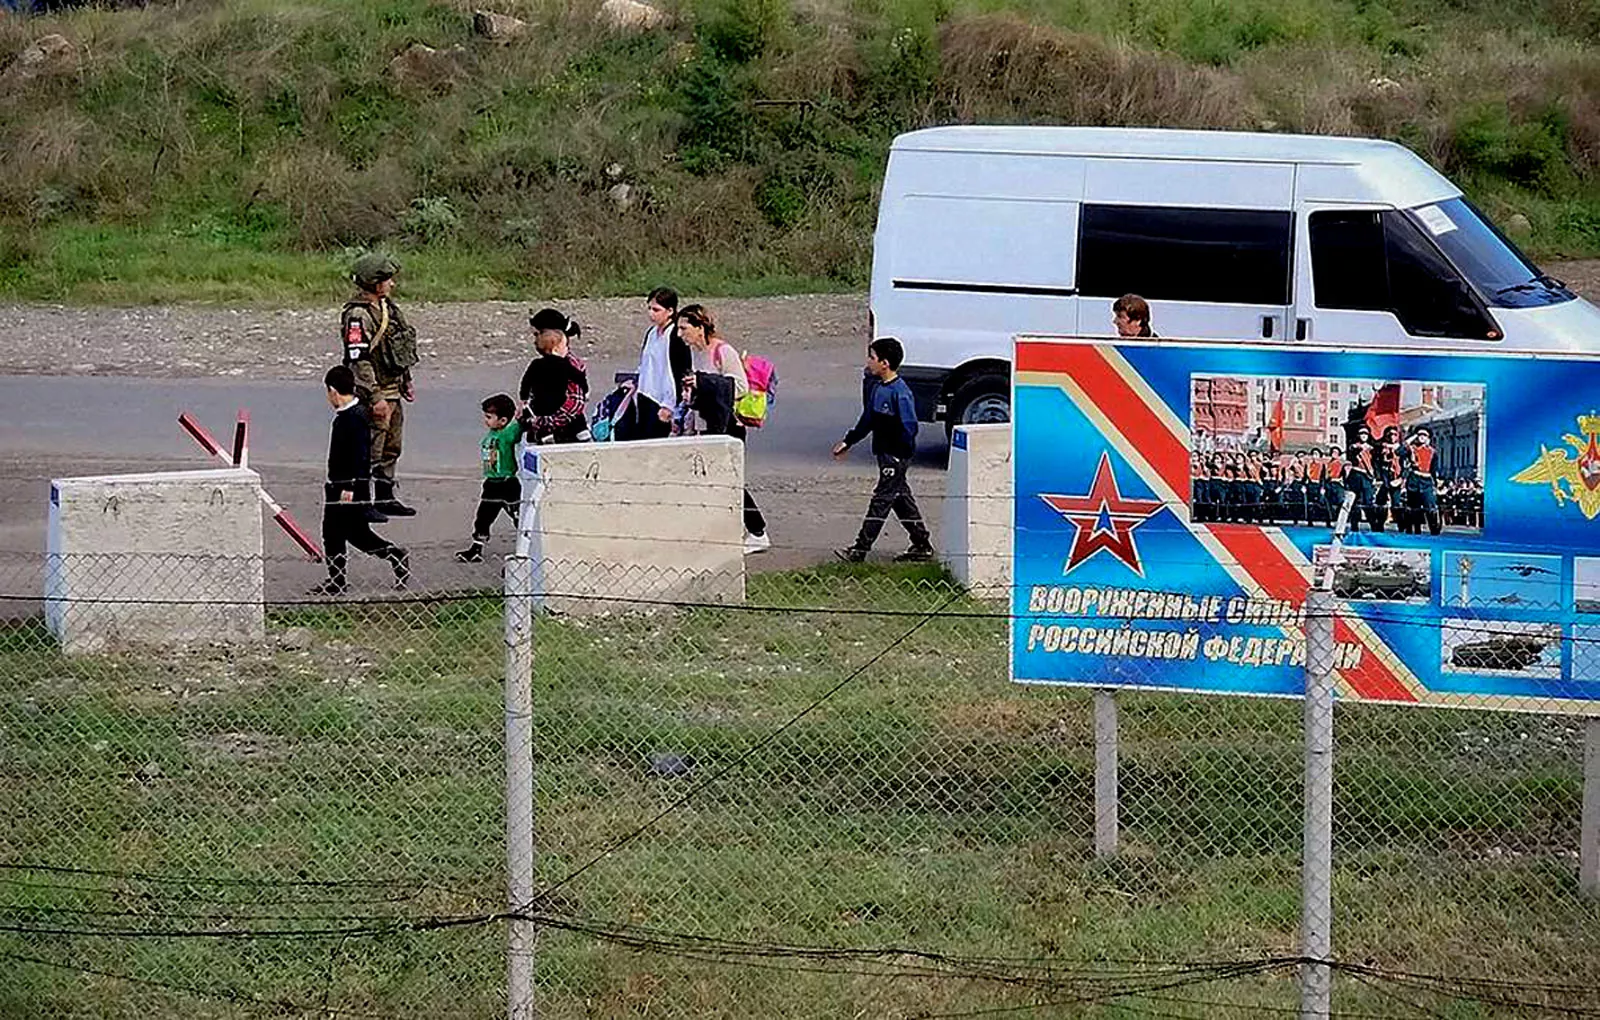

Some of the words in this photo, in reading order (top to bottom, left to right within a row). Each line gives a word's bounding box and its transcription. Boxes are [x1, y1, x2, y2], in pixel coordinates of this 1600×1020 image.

[1028, 585, 1222, 622] ВООРУЖЕННЫЕ
[1027, 623, 1199, 660] РОССИЙСКОЙ
[1203, 635, 1363, 669] ФЕДЕРАИИ
